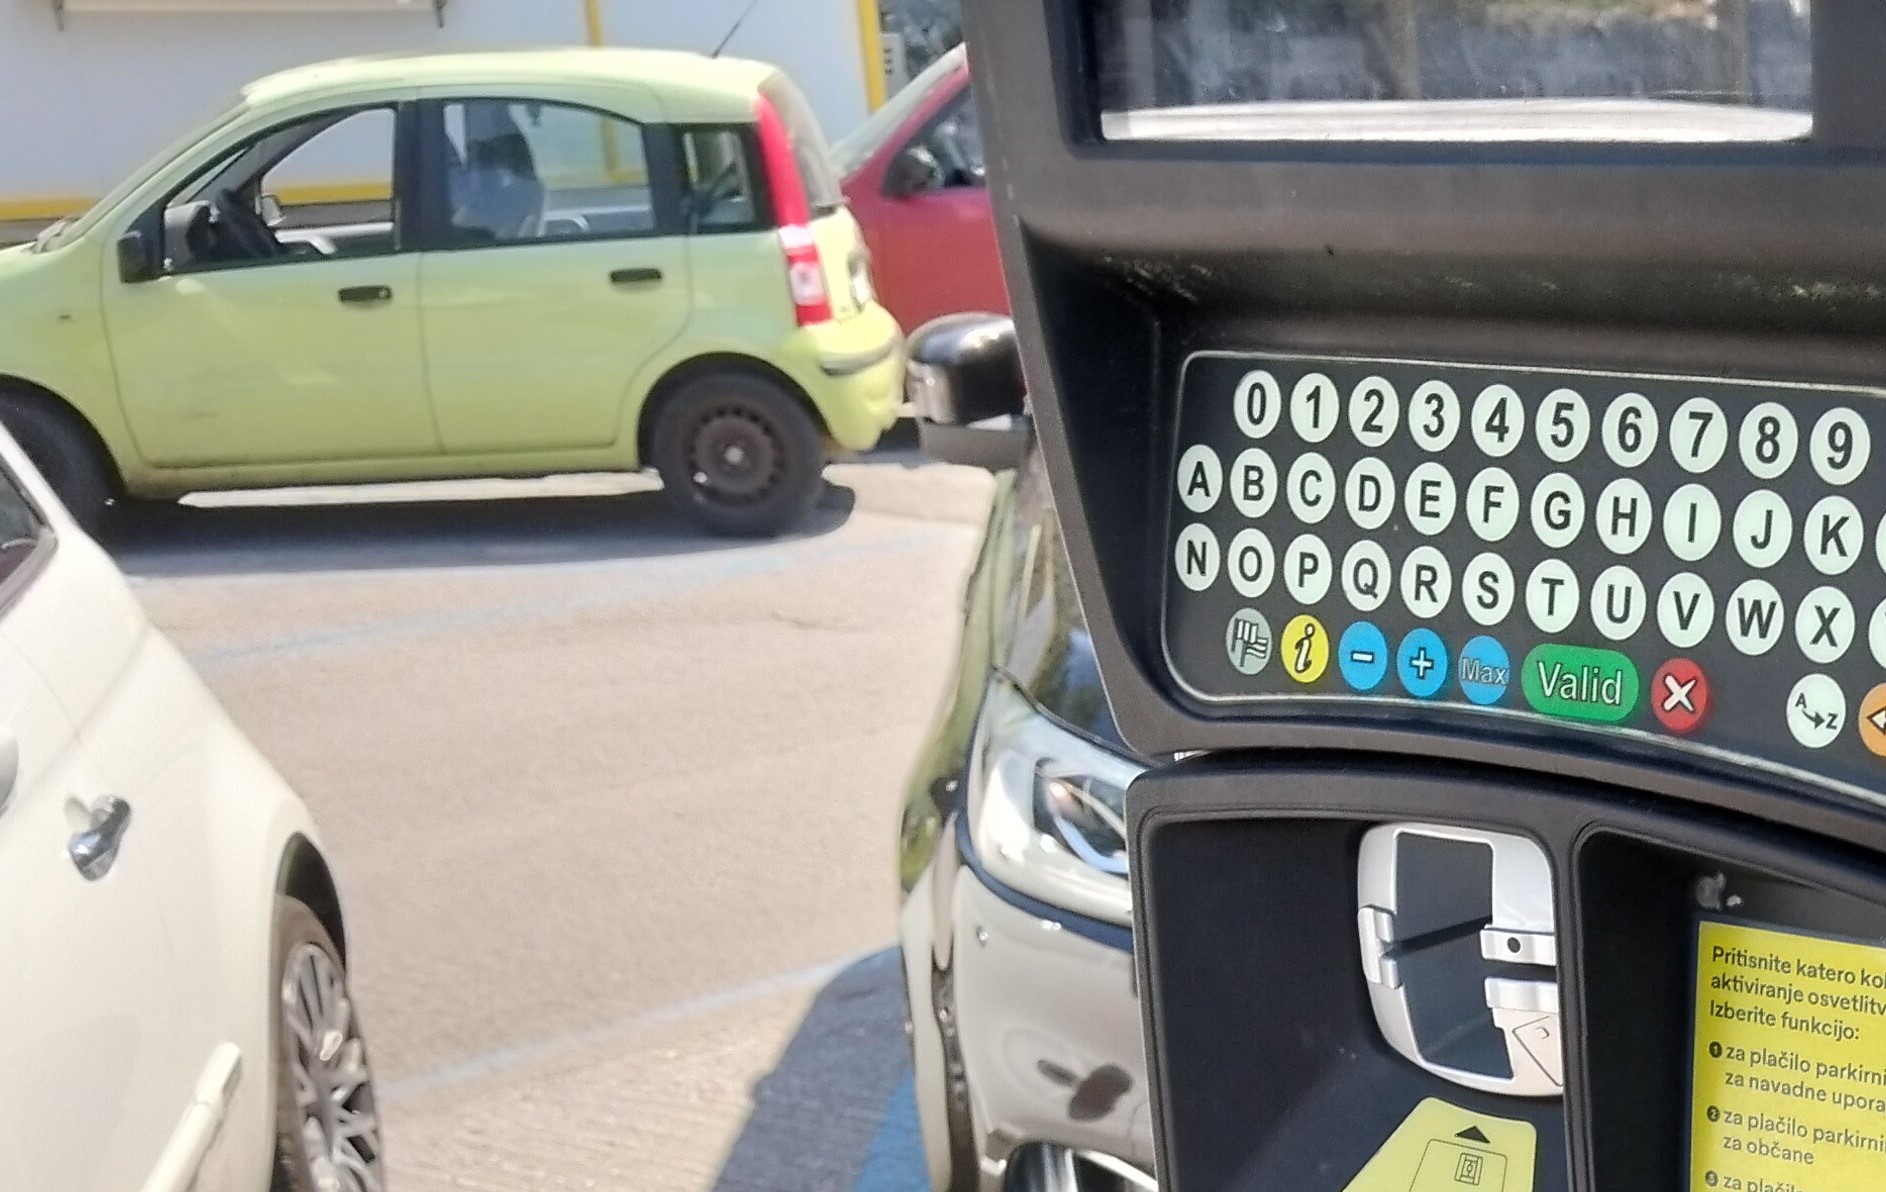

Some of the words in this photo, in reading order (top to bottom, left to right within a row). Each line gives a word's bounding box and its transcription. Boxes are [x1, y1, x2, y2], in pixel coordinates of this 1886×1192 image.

[1246, 381, 1267, 426] 0
[1306, 385, 1321, 429] 1
[1361, 388, 1385, 434] 2
[1423, 392, 1445, 438] 3
[1485, 397, 1510, 443] 4
[1550, 401, 1575, 448] 5
[1617, 406, 1642, 453] 6
[1688, 411, 1714, 458] 7
[1755, 415, 1781, 465] 8
[1827, 421, 1853, 470] 9
[1187, 460, 1211, 498] A
[1243, 464, 1265, 502] B
[1299, 469, 1322, 507] C
[1358, 474, 1382, 512] D
[1419, 479, 1442, 519] E
[1483, 485, 1505, 524] F
[1543, 490, 1571, 531] G
[1611, 496, 1638, 537] H
[1687, 502, 1697, 543] I
[1750, 509, 1773, 550] J
[1820, 514, 1850, 557] K
[1186, 539, 1207, 577] N
[1238, 545, 1263, 583] O
[1298, 551, 1319, 588] P
[1353, 557, 1379, 600] Q
[1414, 563, 1438, 603] R
[1476, 570, 1499, 610] S
[1541, 577, 1565, 616] T
[1606, 584, 1632, 624] U
[1673, 590, 1701, 631] V
[1737, 597, 1777, 639] W
[1809, 605, 1841, 648] X
[1461, 656, 1509, 686] Max
[1537, 659, 1623, 705] Valid
[1712, 945, 1791, 974] Pritisnite
[1796, 958, 1856, 985] katero
[1711, 972, 1804, 1005] aktiviranje
[1710, 999, 1776, 1027] Izberite
[1781, 1011, 1859, 1041] funkcijo:
[1726, 1046, 1745, 1062] za
[1750, 1048, 1811, 1073] plačilo
[1725, 1072, 1744, 1087] za
[1749, 1076, 1827, 1102] navadne
[1723, 1110, 1743, 1125] za
[1748, 1113, 1808, 1138] plačilo
[1723, 1136, 1742, 1151] za
[1747, 1138, 1814, 1165] občane
[1724, 1176, 1742, 1190] za
